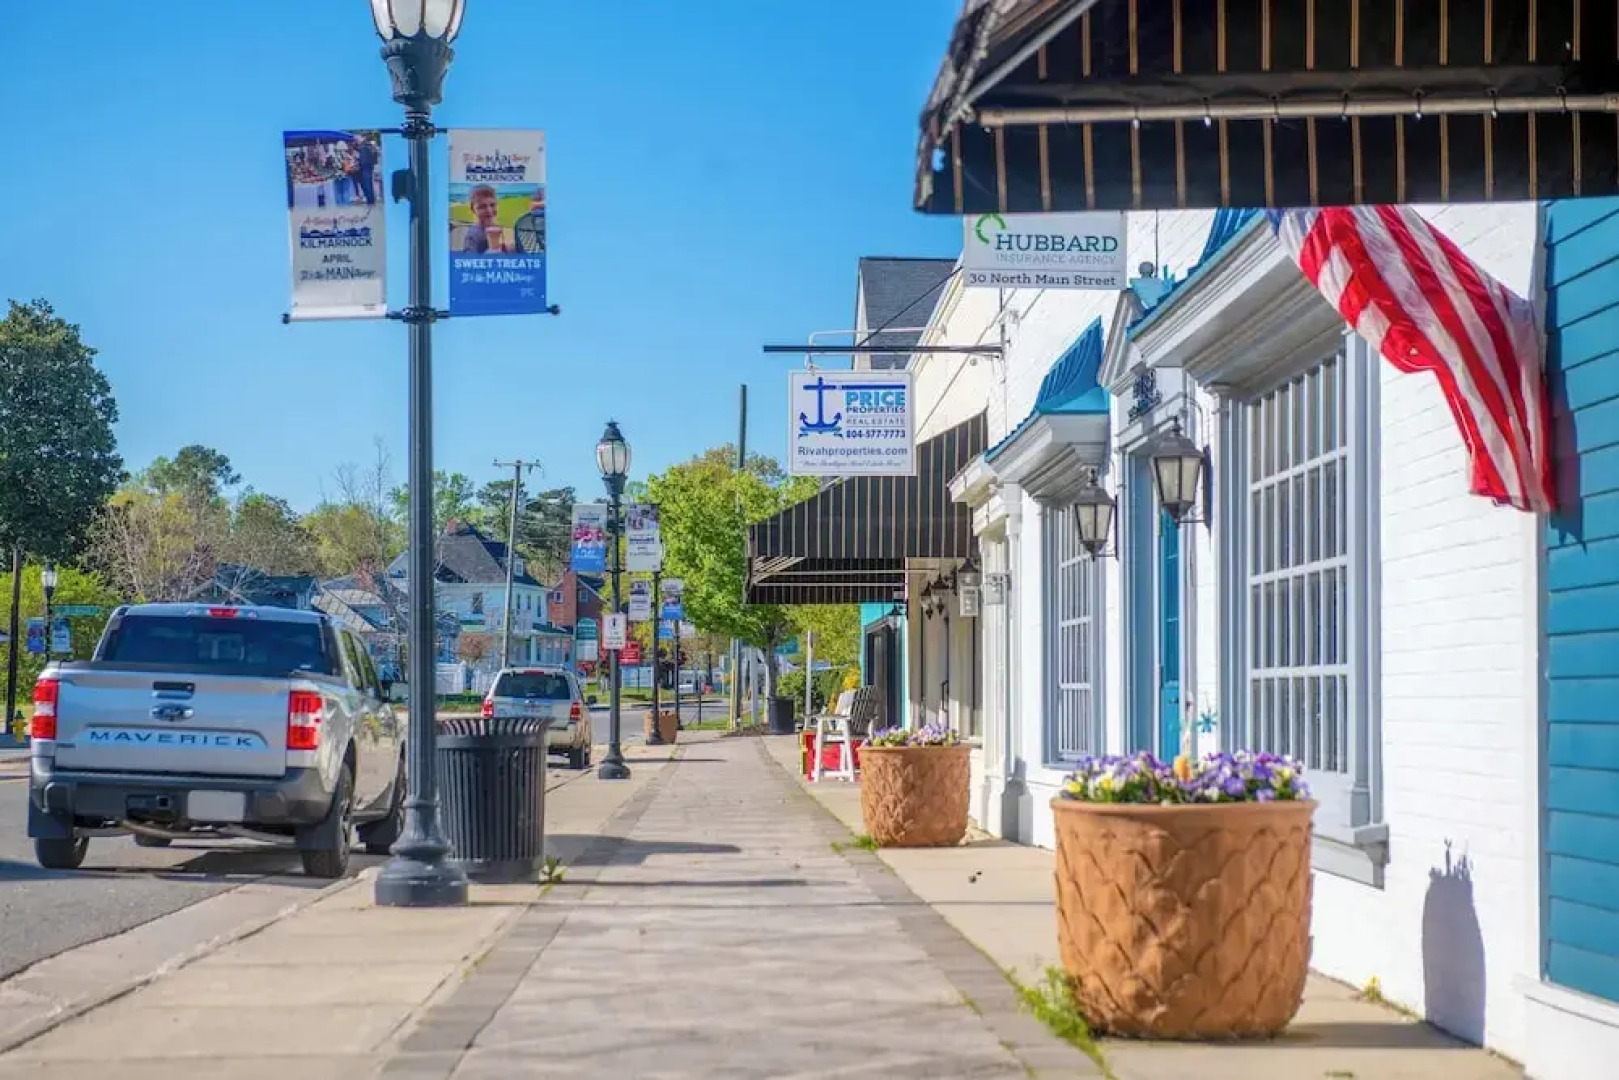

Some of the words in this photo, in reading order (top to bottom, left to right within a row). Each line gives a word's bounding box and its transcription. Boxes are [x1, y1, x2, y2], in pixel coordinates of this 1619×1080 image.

[300, 237, 373, 249] KILMARNOCK
[995, 233, 1118, 252] HUBBARD
[322, 254, 353, 263] APRIL
[454, 259, 493, 269] SWEET
[496, 259, 541, 269] TREATS
[996, 253, 1067, 264] INSURANCE
[1069, 255, 1117, 265] AGENCY
[969, 273, 987, 284] 30
[990, 273, 1031, 285] North
[1035, 274, 1070, 286] Main
[1074, 275, 1117, 287] Street
[845, 391, 906, 406] PRICE
[797, 446, 908, 458] Rivahproperties.com
[90, 731, 253, 747] MAVERICK
